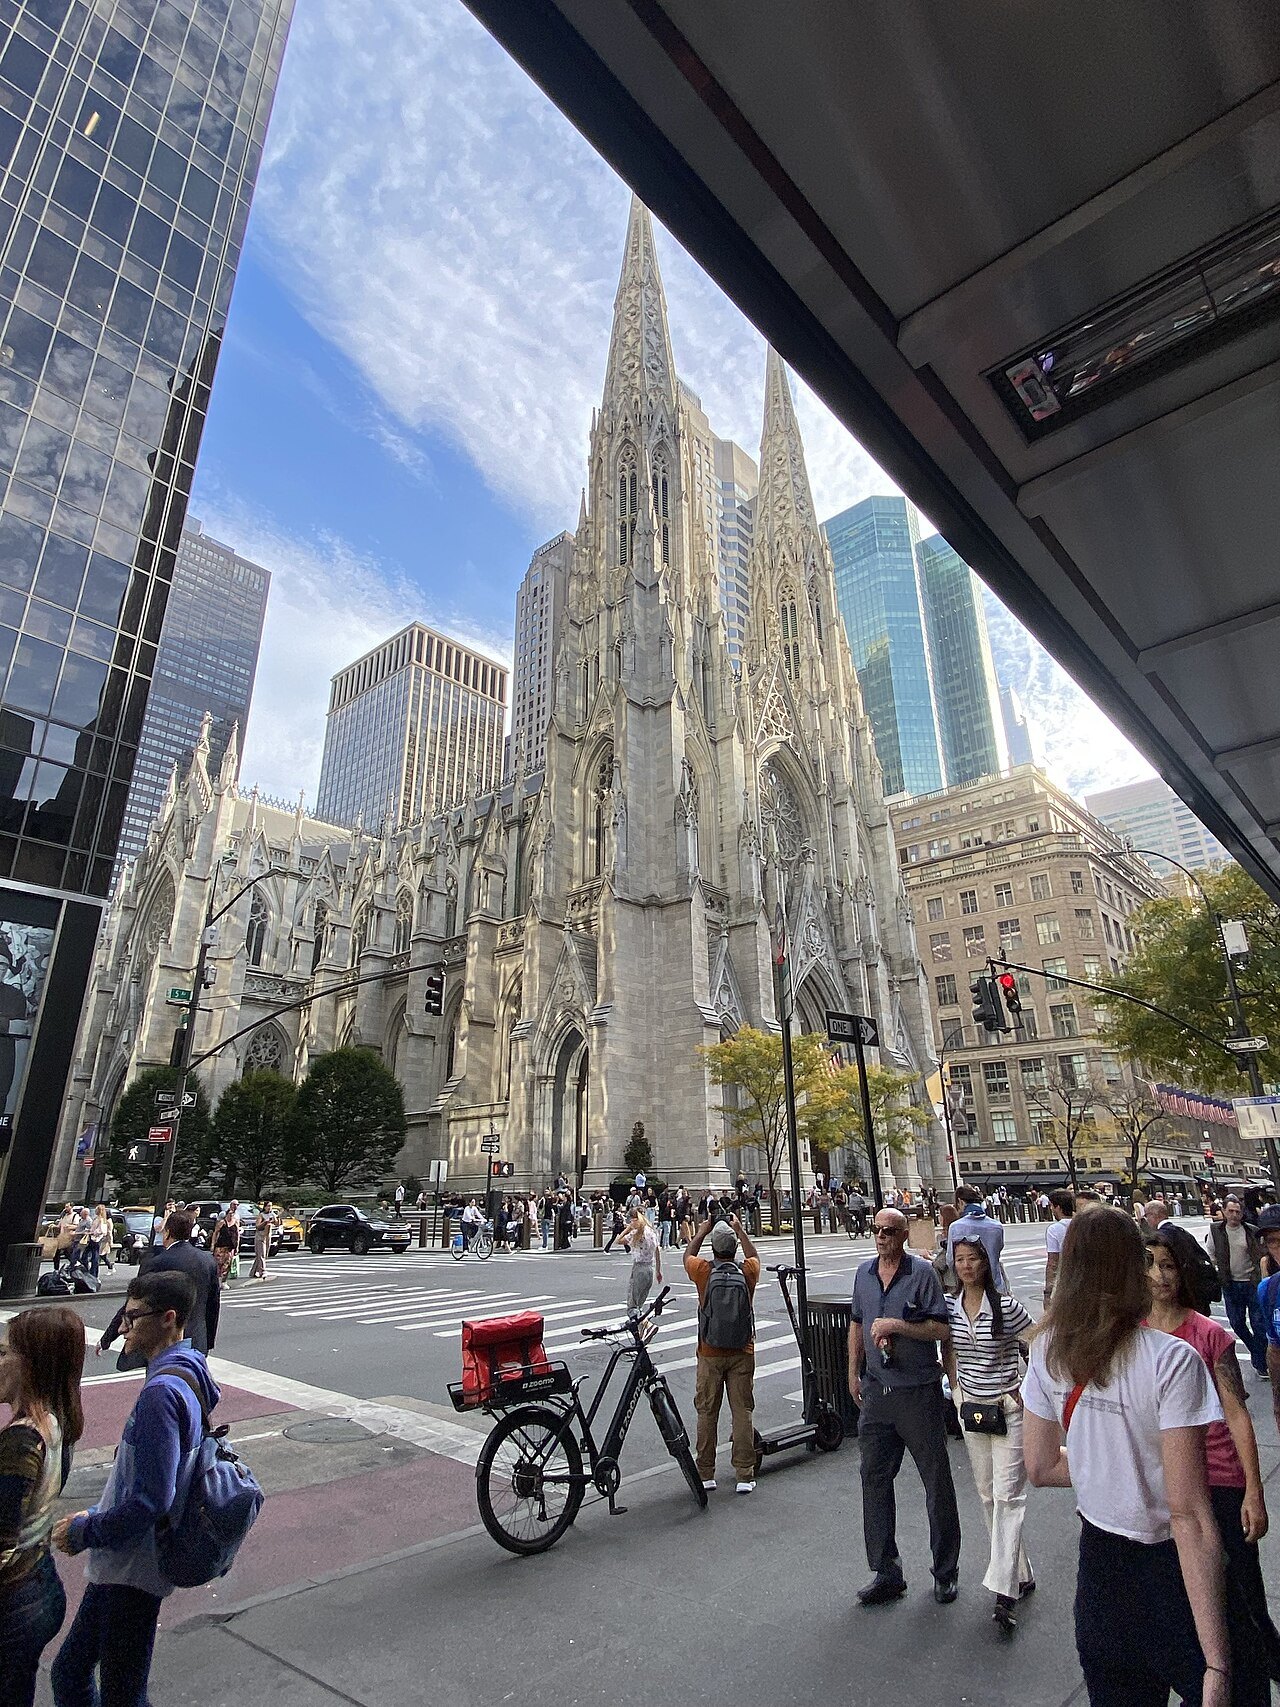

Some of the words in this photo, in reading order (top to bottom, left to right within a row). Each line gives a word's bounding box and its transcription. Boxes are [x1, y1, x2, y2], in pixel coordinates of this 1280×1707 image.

[833, 1020, 848, 1034] ONE
[528, 1377, 555, 1388] zoomo
[623, 1378, 644, 1427] zoomo
